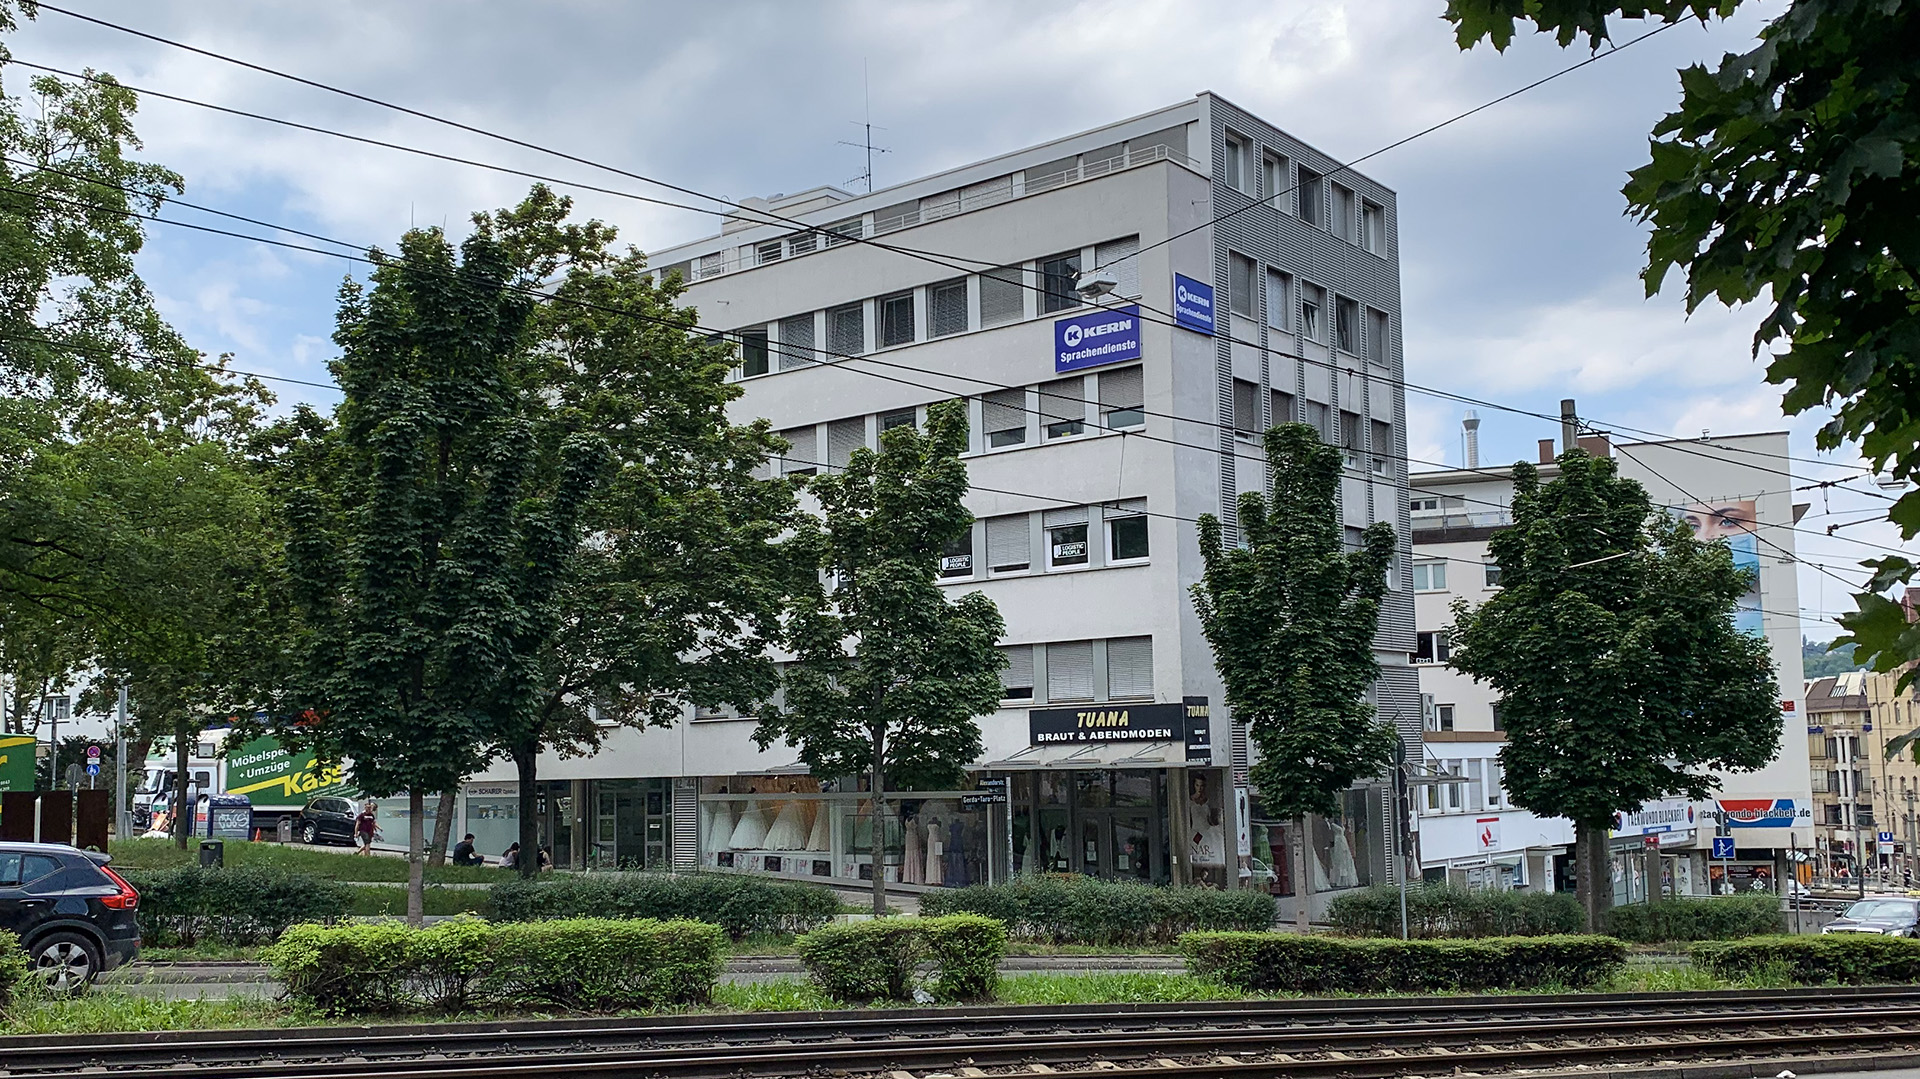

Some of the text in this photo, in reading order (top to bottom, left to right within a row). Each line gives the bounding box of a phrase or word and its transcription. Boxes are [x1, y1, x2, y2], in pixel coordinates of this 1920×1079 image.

[1187, 292, 1210, 308] KERN
[1176, 303, 1212, 324] Sprachendienste
[1083, 319, 1132, 339] KERN
[1060, 339, 1136, 364] Sprachendienste
[1061, 543, 1084, 551] LOGISTIC
[1077, 710, 1130, 728] TUANA
[1186, 705, 1209, 718] TUANA
[1037, 728, 1172, 742] BRAUT & ABENDMODEN
[246, 760, 291, 779] Umzüge
[1627, 808, 1685, 826] TAEKWONDO BLACKBELT
[1881, 832, 1890, 840] U
